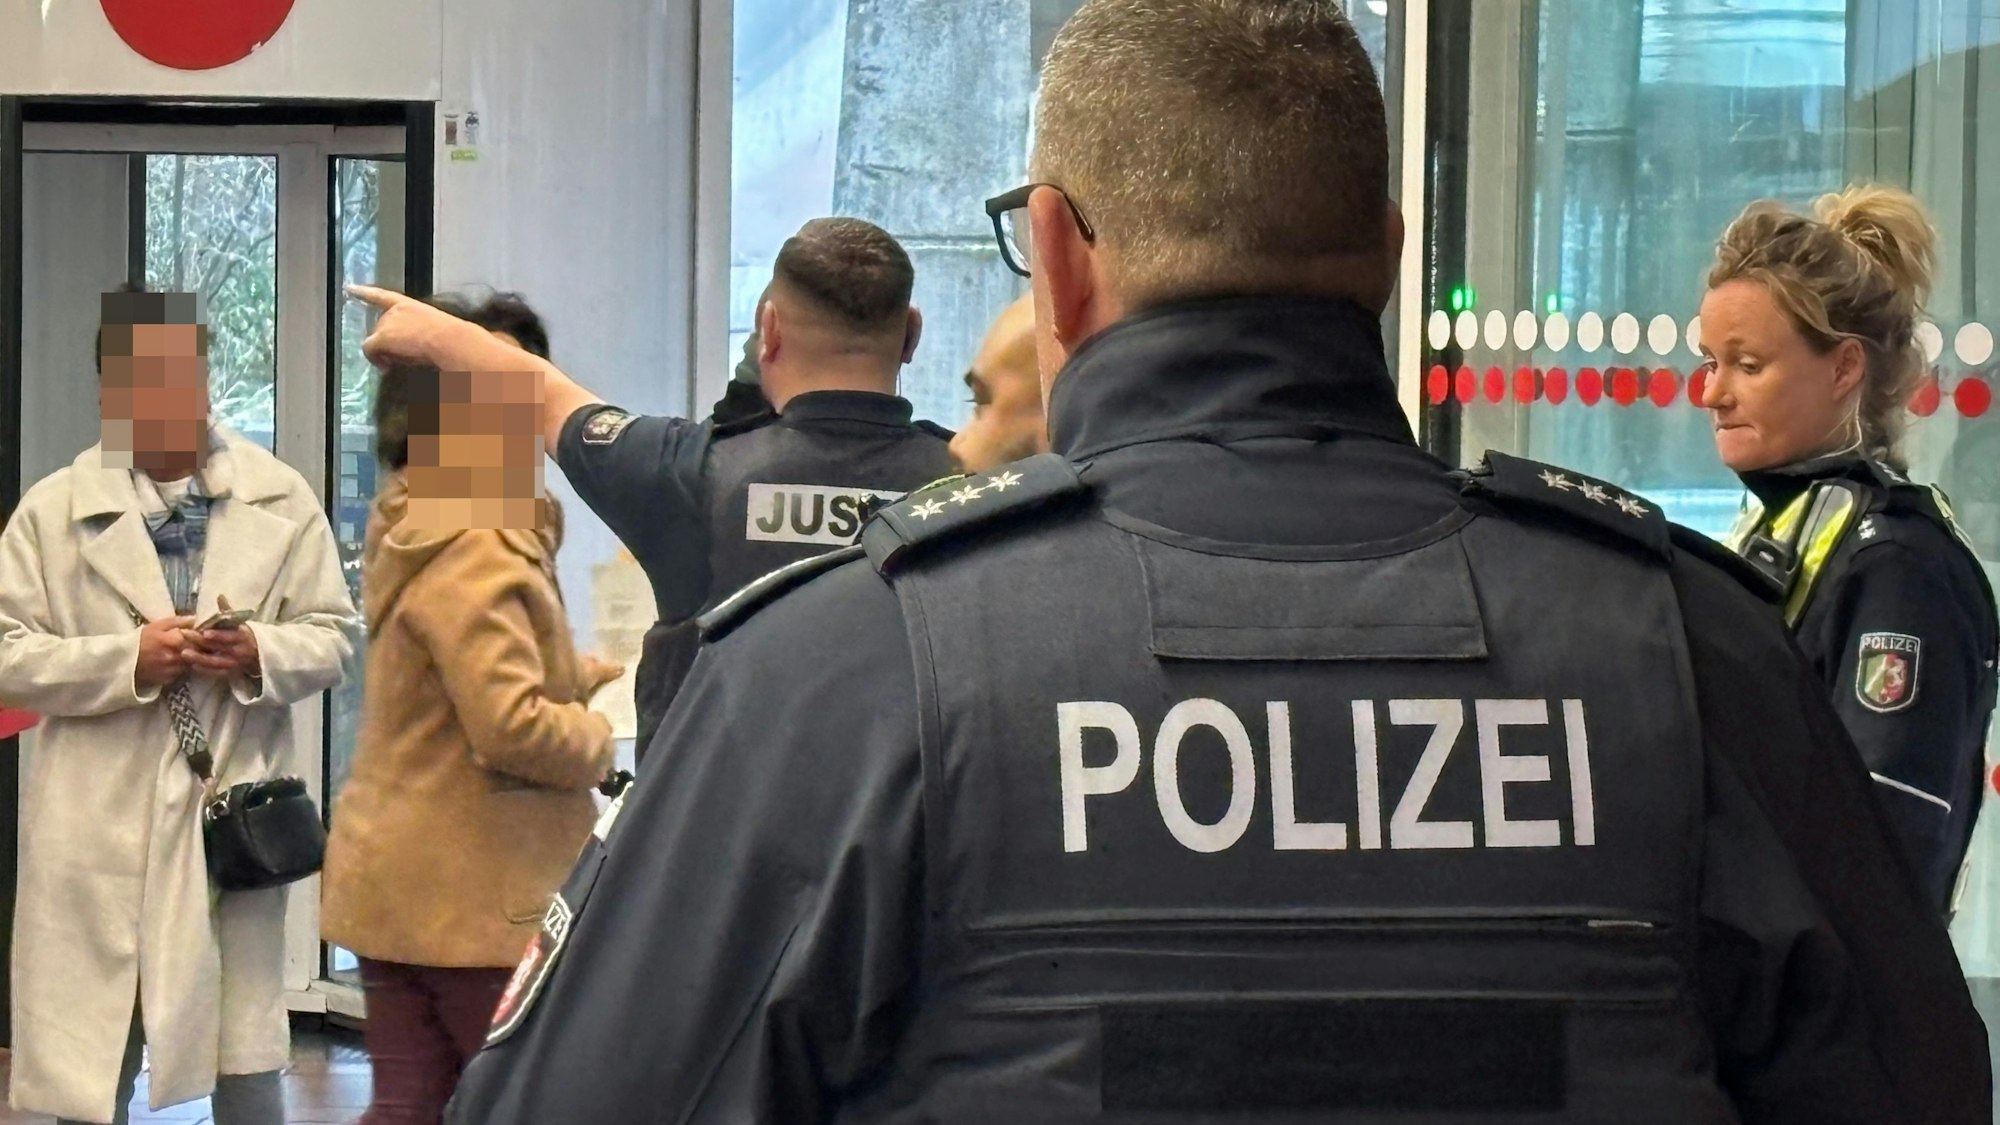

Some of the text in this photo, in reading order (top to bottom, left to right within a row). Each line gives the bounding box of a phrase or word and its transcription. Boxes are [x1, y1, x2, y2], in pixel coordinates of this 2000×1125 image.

[755, 491, 860, 538] JUS
[1861, 636, 1917, 653] POLIZEI
[1056, 697, 1597, 854] POLIZEI
